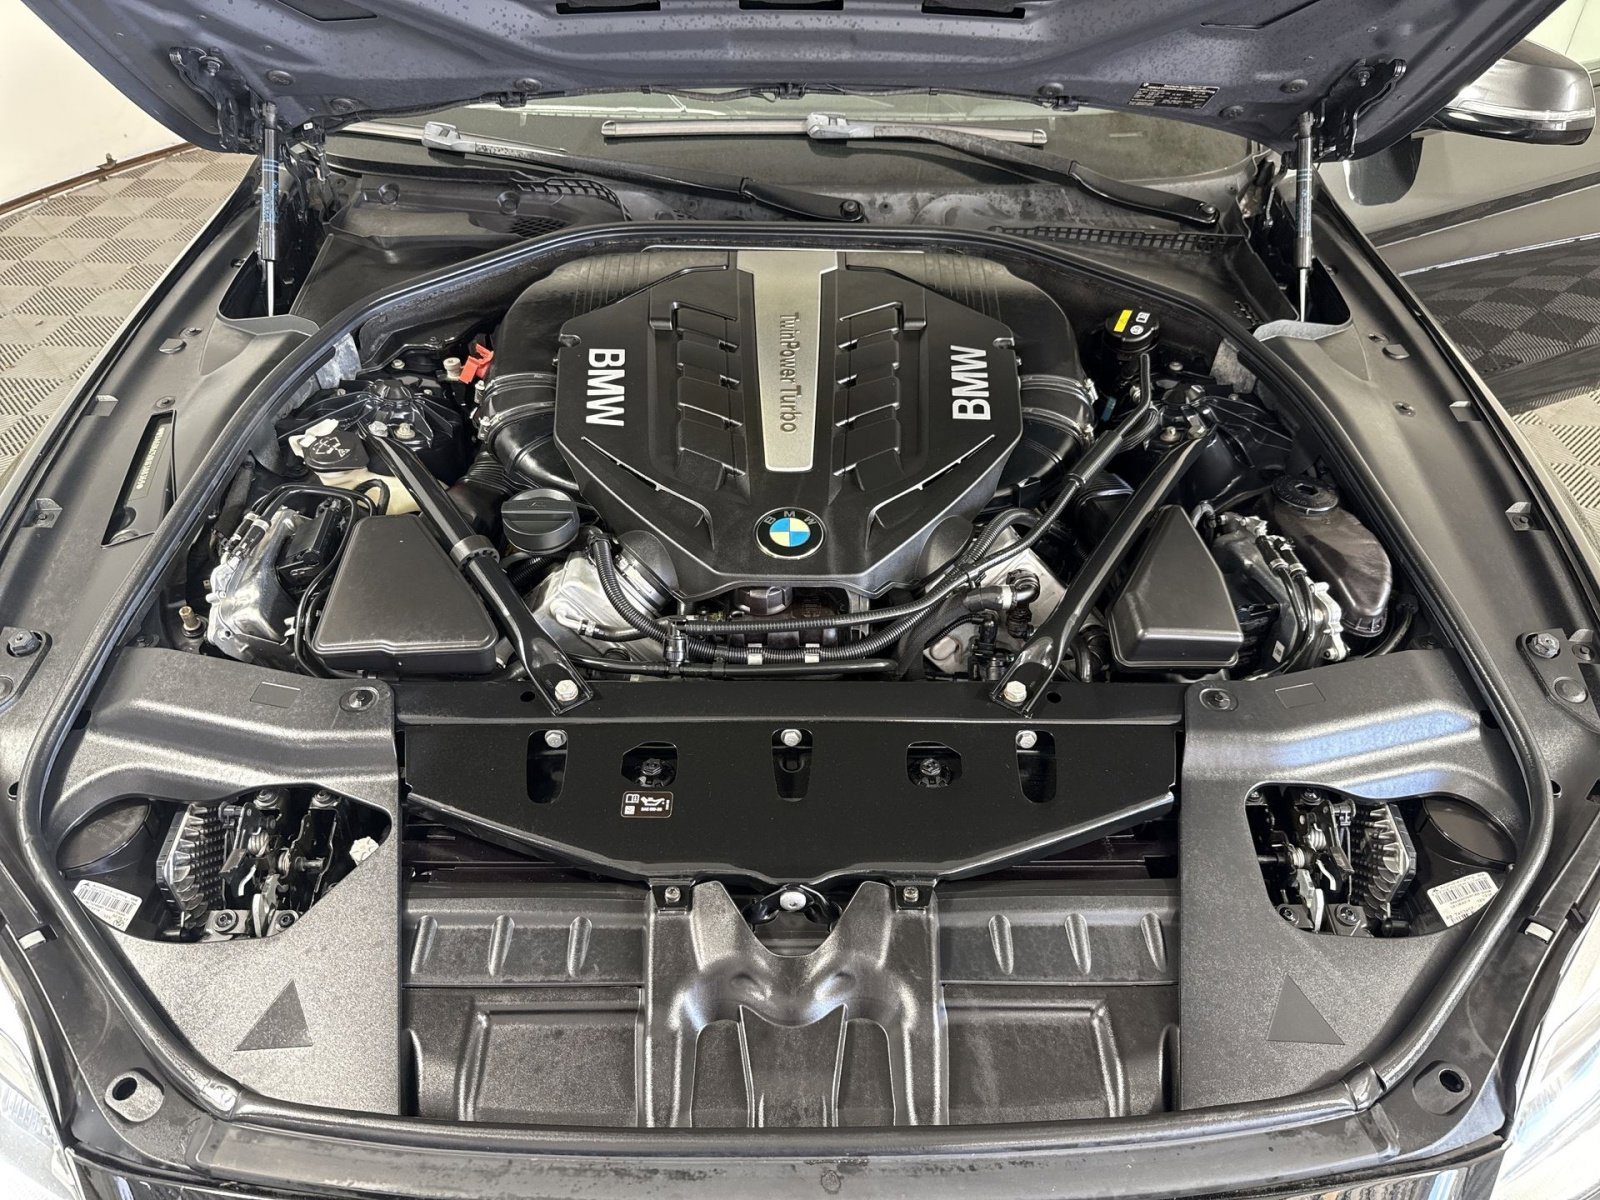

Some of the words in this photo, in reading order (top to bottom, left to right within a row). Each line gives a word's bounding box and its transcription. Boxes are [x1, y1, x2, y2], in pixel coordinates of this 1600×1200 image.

[779, 312, 800, 384] TwinPower
[950, 345, 991, 420] BMW
[586, 348, 625, 426] BMW
[779, 385, 802, 433] Turbo
[763, 510, 817, 526] BMW
